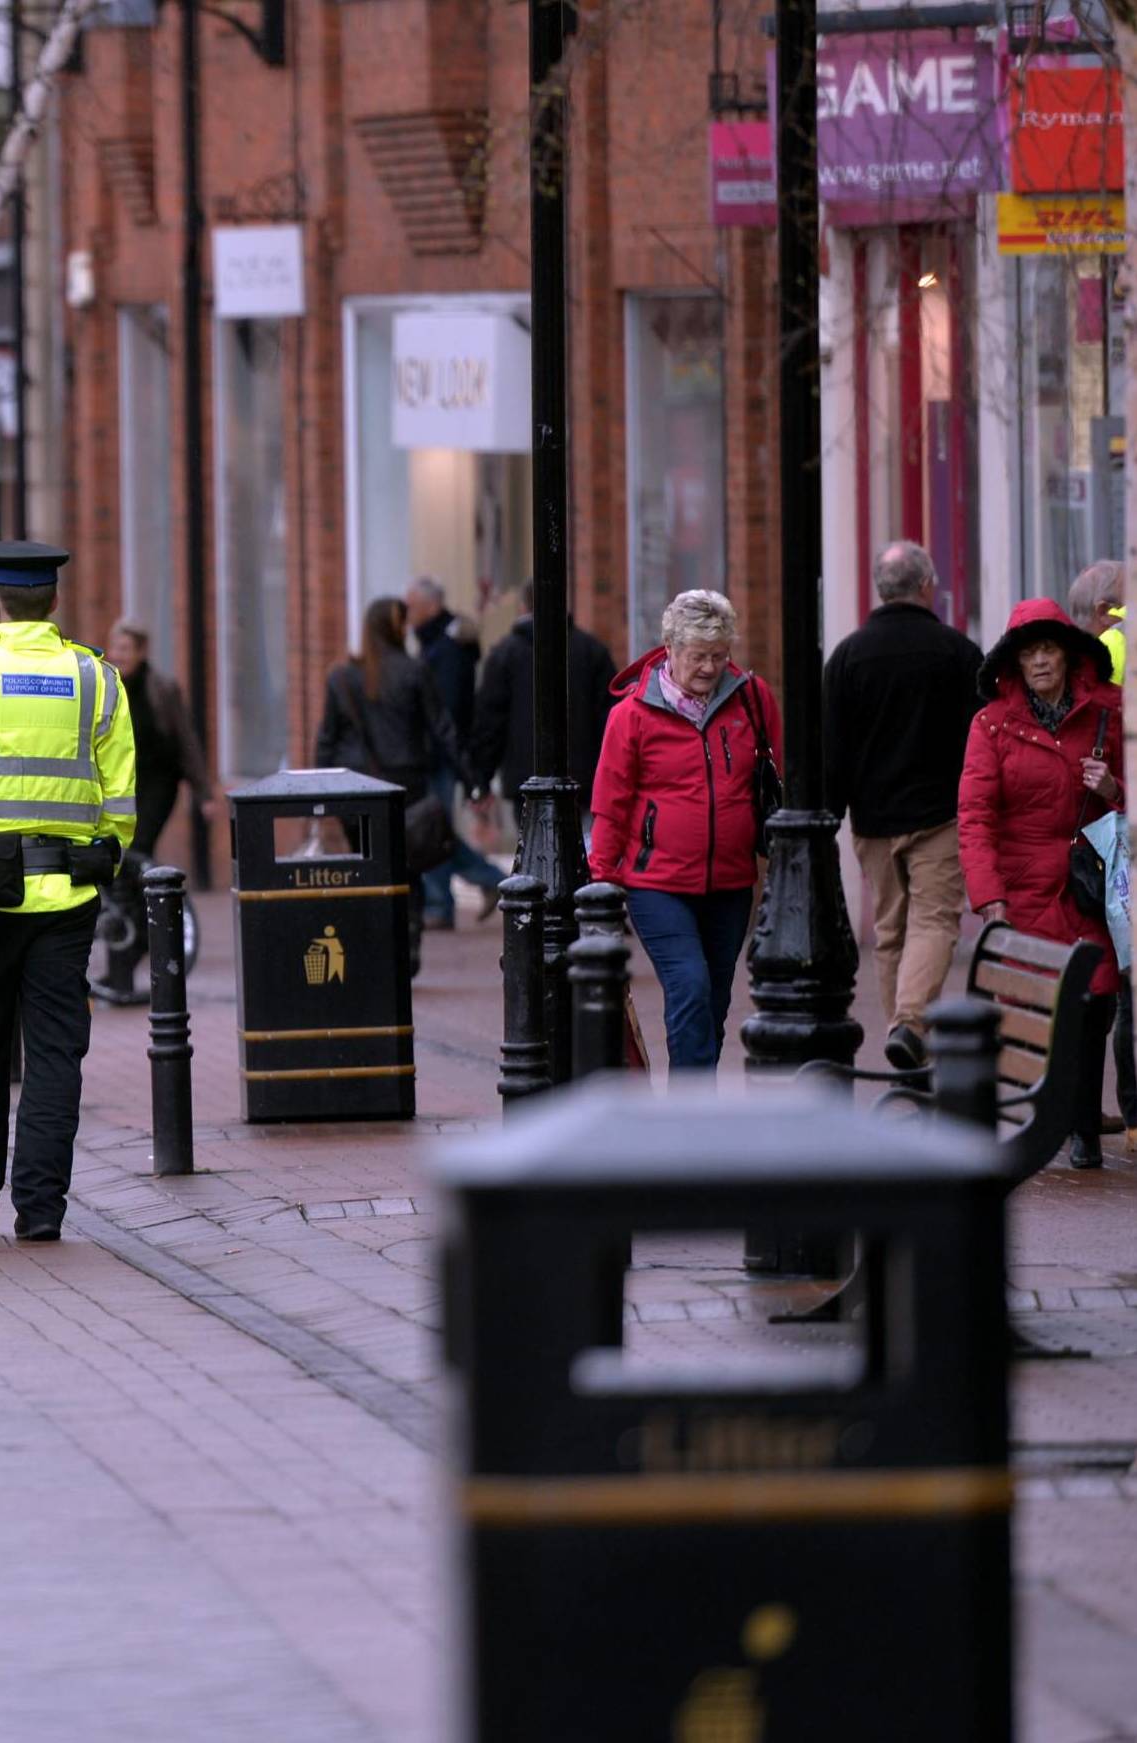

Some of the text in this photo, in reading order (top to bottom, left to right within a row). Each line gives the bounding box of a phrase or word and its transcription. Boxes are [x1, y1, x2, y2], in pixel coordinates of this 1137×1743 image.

[817, 55, 977, 118] GAME
[1021, 112, 1126, 129] Ryman
[818, 155, 981, 190] ww.game.net
[295, 867, 352, 887] Litter
